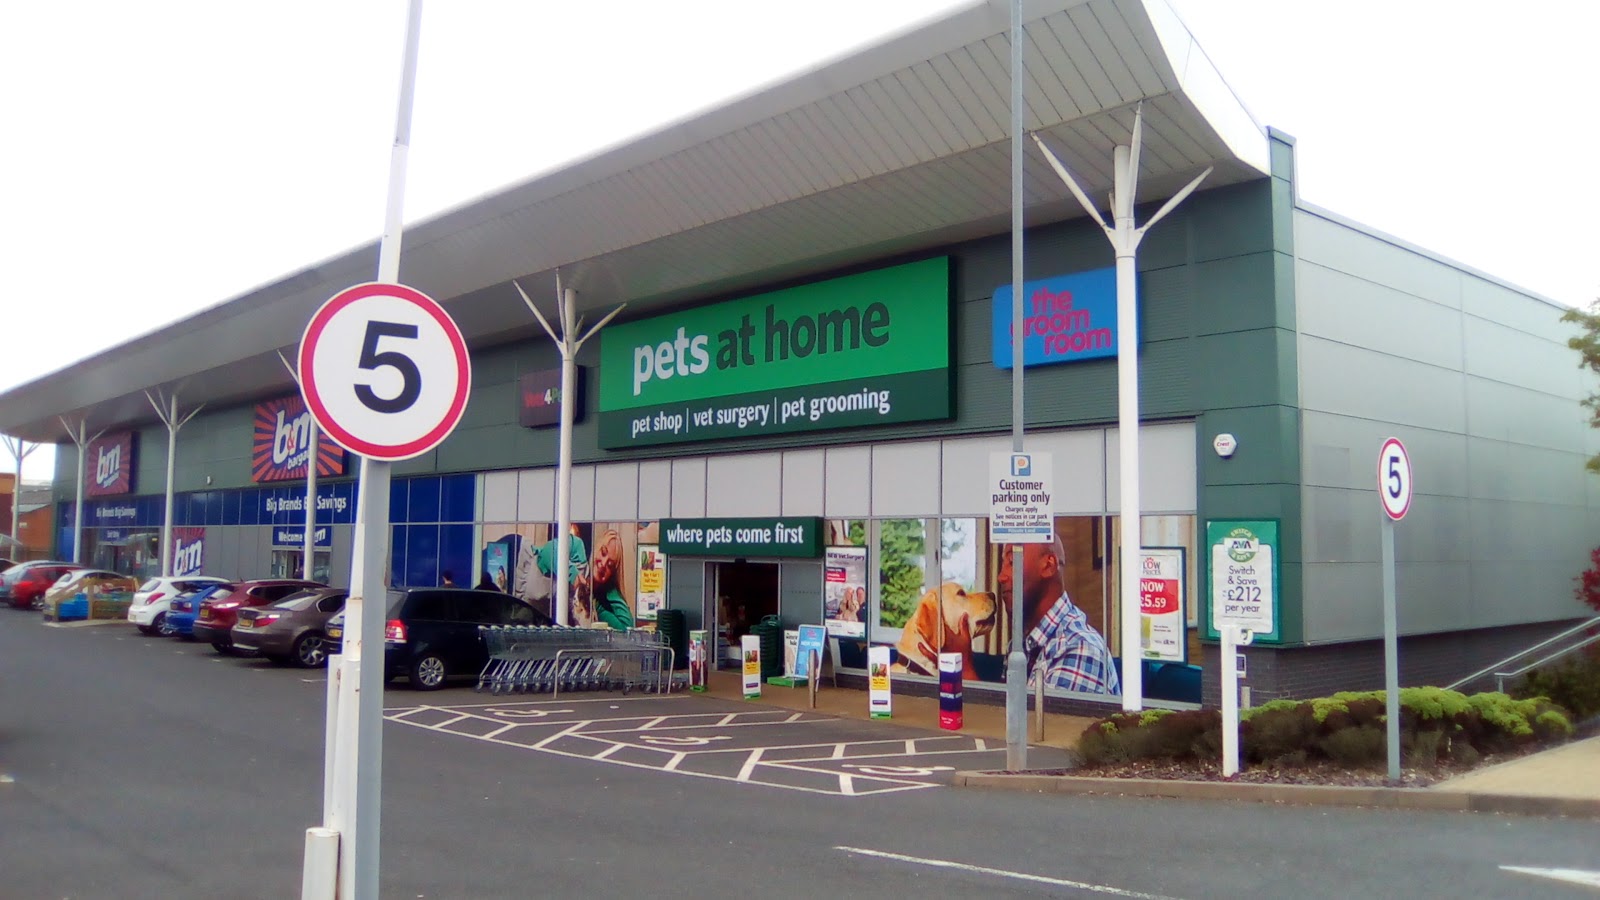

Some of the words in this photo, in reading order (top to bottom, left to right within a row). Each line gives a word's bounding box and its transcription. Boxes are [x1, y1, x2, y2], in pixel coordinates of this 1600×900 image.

[1031, 287, 1073, 314] the
[633, 327, 709, 396] pets
[716, 314, 756, 371] at
[764, 302, 890, 363] home
[1044, 328, 1112, 355] room
[353, 320, 422, 414] 5
[632, 414, 650, 438] pet
[654, 410, 683, 434] shop
[693, 408, 714, 427] vet
[716, 404, 770, 429] surgery
[781, 398, 805, 424] pet
[810, 388, 890, 421] grooming
[288, 451, 310, 470] barga
[999, 479, 1043, 490] Customer
[1388, 456, 1402, 499] 5
[266, 498, 277, 514] Big
[278, 496, 302, 511] Brands
[317, 494, 347, 512] Savings
[992, 491, 1028, 505] parking
[1030, 491, 1050, 505] only
[1037, 513, 1047, 521] park
[278, 531, 303, 542] Welcome
[667, 524, 703, 543] where
[706, 526, 732, 548] pets
[736, 528, 771, 543] come
[775, 522, 804, 544] first
[1231, 540, 1251, 549] AVA
[1142, 561, 1161, 570] LOW
[1228, 565, 1256, 575] Switch
[1141, 581, 1164, 592] NOW
[1228, 576, 1235, 585] &
[1236, 576, 1257, 585] Save
[1227, 586, 1261, 602] £212
[1225, 605, 1239, 613] per
[1240, 605, 1260, 614] year
